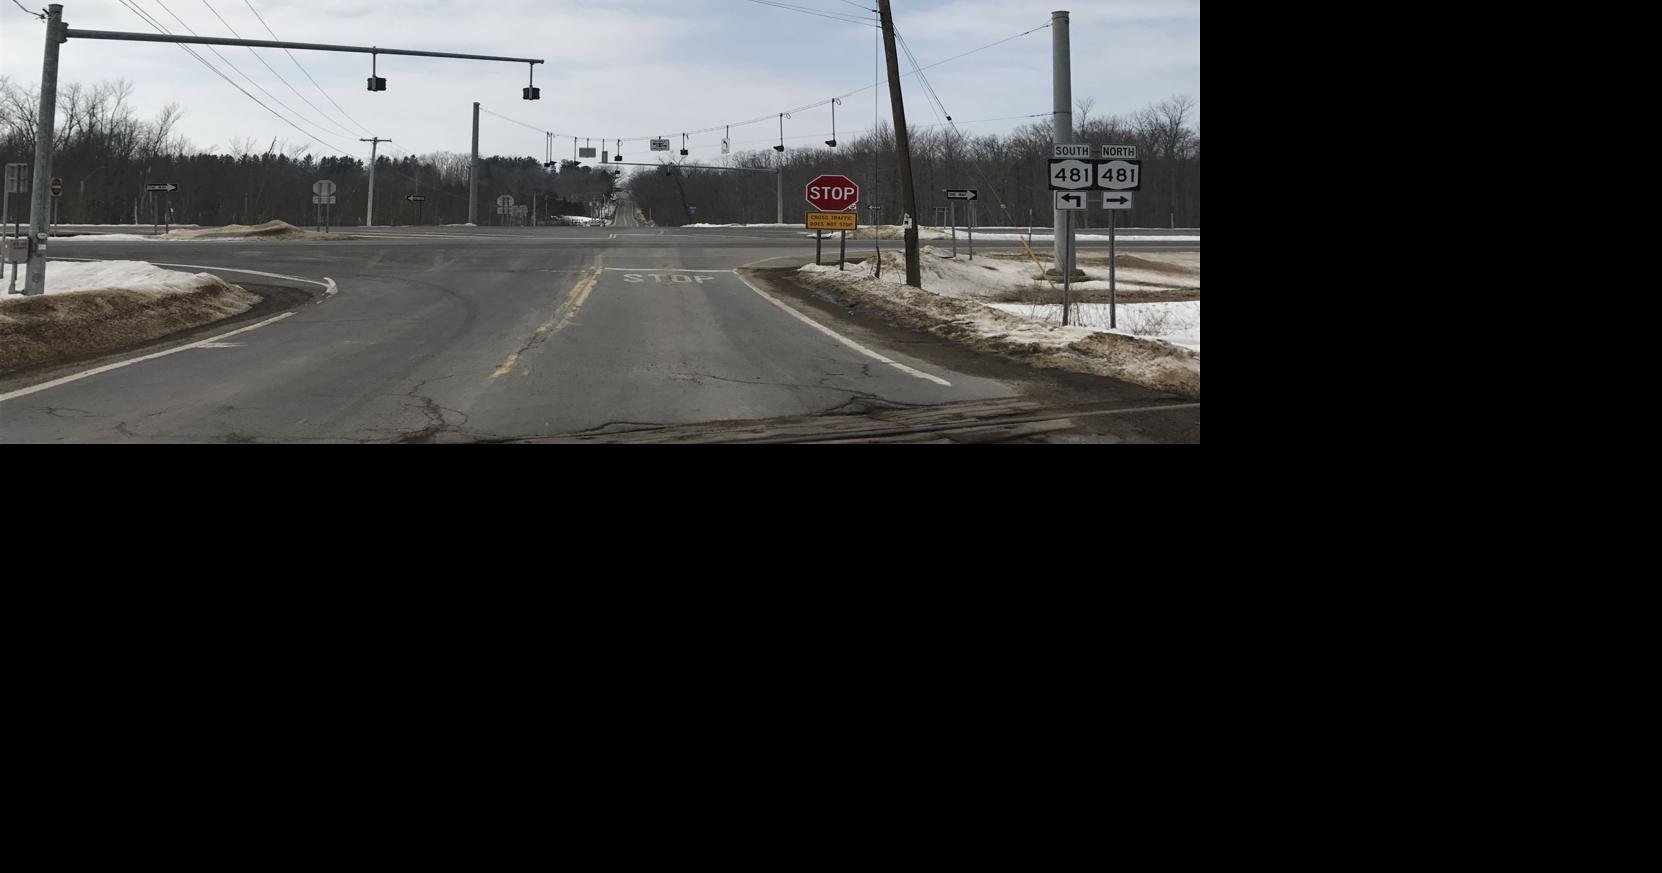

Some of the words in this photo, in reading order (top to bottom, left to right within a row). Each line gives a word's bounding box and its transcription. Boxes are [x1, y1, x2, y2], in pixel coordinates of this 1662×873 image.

[1055, 146, 1089, 156] SOUTH
[1103, 147, 1135, 157] NORTH
[1054, 167, 1088, 182] 481
[1102, 168, 1135, 183] 481
[810, 186, 855, 200] STOP
[623, 273, 715, 284] STOP
